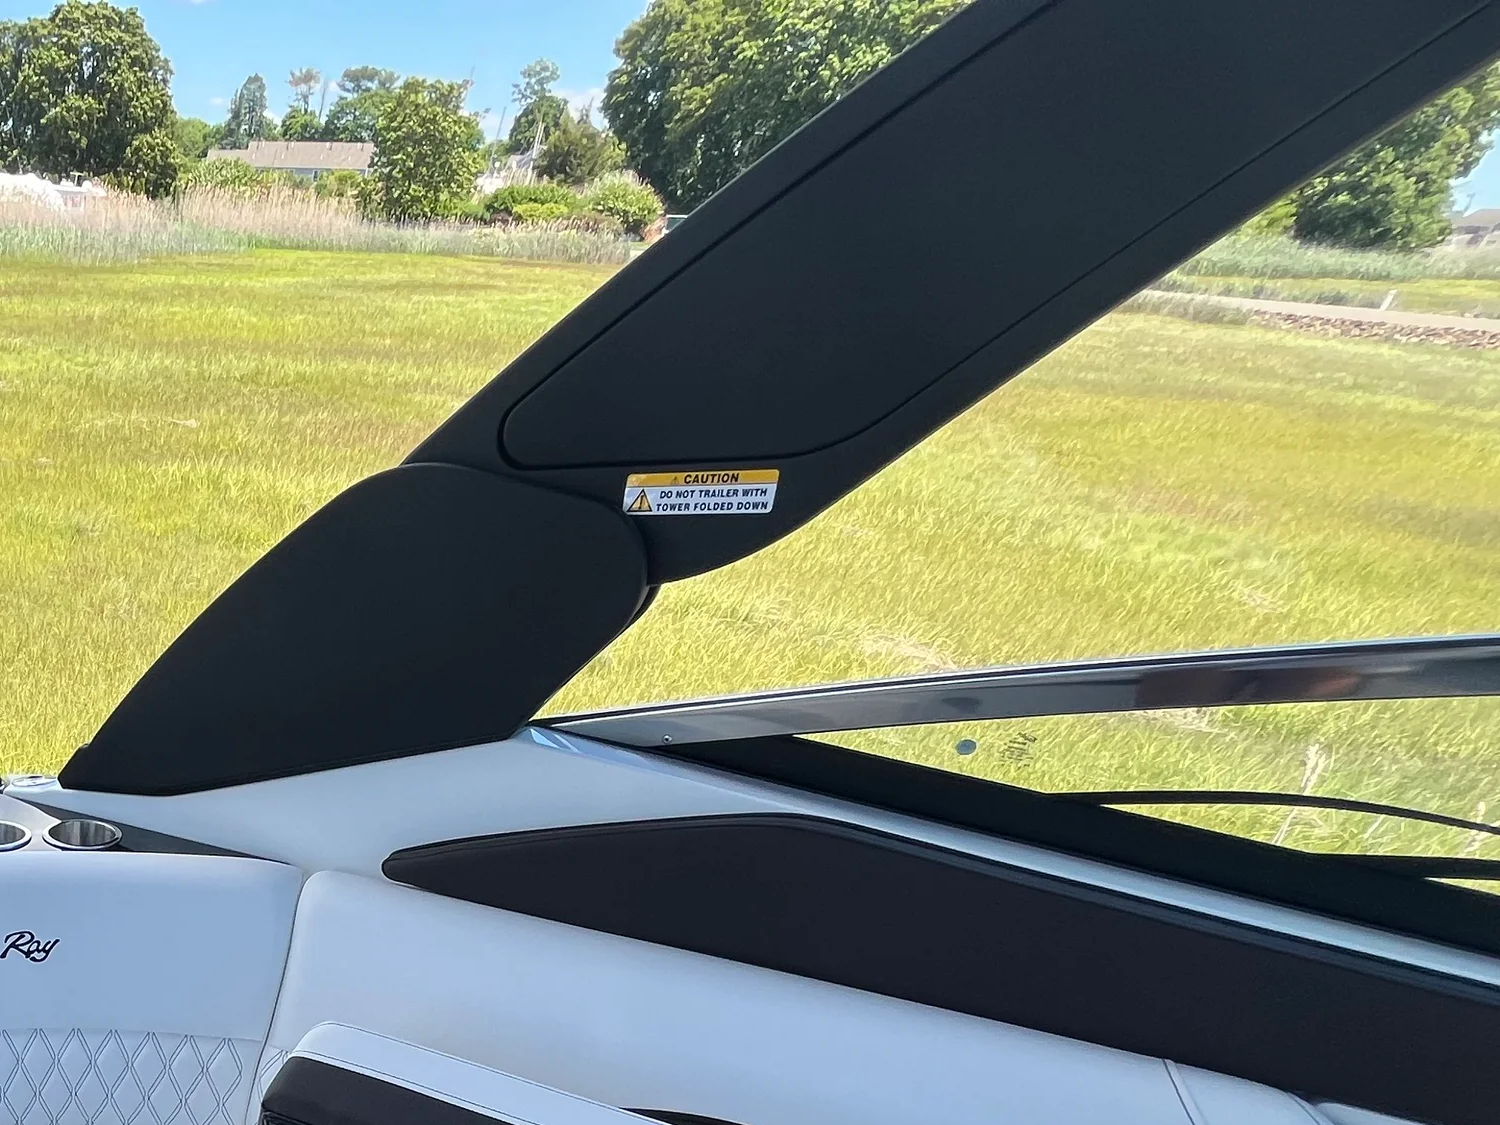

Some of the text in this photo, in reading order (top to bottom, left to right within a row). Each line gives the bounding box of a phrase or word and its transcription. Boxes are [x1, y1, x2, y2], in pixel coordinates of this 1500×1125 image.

[683, 472, 740, 484] CAUTION
[660, 488, 768, 499] DO NOT TRAILER WITH
[656, 501, 768, 512] TOWER FOLDED DOWN
[0, 930, 60, 963] Ray
